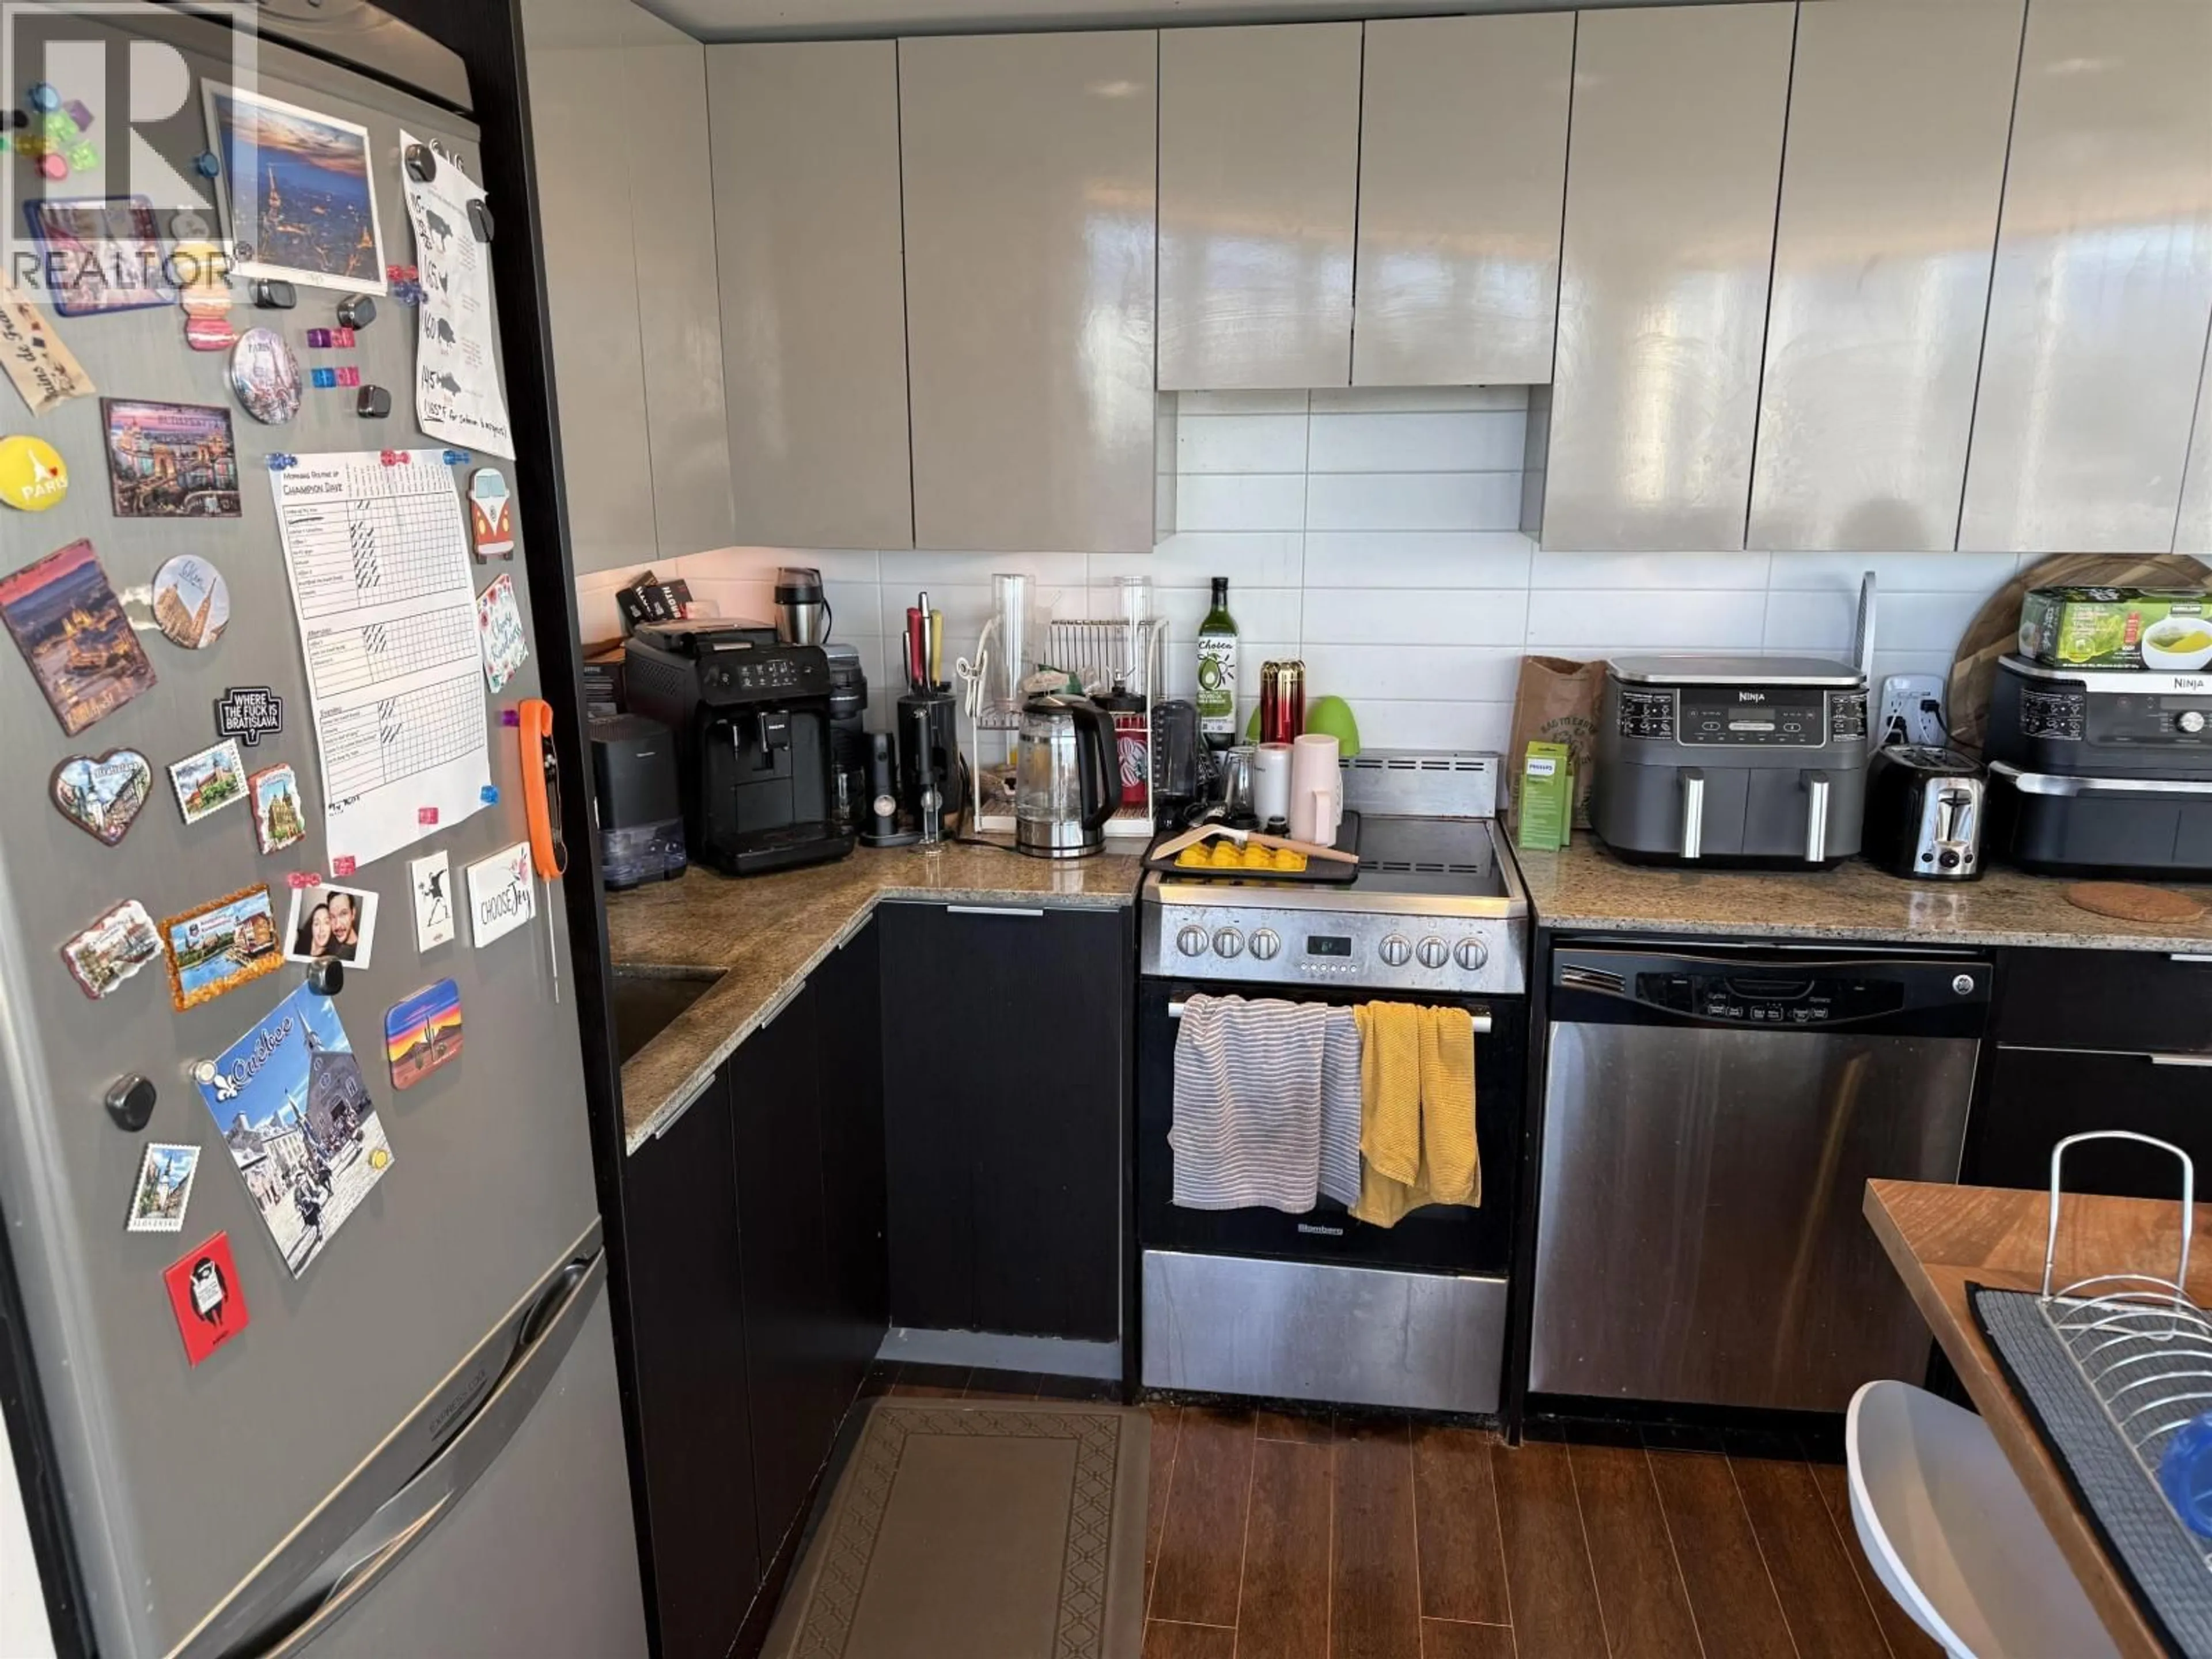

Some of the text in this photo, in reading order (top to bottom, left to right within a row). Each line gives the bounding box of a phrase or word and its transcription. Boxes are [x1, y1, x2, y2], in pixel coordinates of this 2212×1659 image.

[22, 474, 69, 502] PARIS
[2173, 677, 2205, 691] NINJA
[234, 693, 267, 706] WHERE
[1738, 691, 1766, 702] NINJA
[224, 704, 278, 718] THE FUCK IS
[226, 718, 278, 729] BRATISLAVA
[249, 728, 255, 740] ?
[481, 889, 512, 926] CHOOSE
[232, 1016, 294, 1090] Québec
